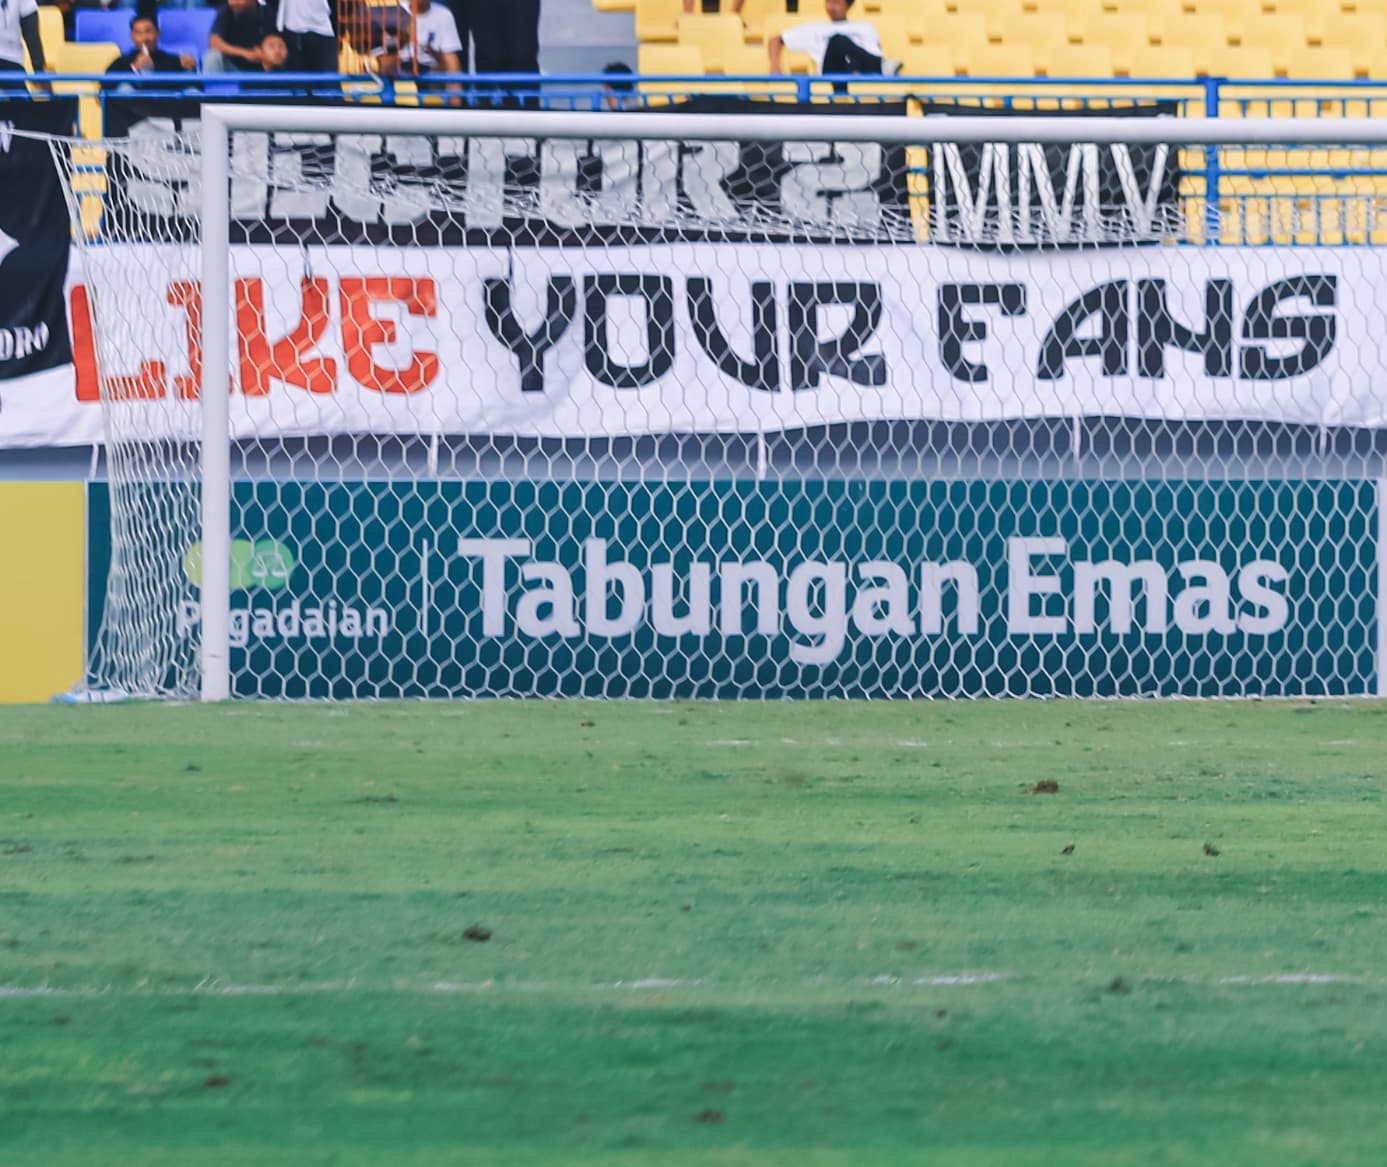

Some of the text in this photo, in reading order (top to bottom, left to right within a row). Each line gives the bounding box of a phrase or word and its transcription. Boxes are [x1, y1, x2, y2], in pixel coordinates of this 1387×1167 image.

[127, 116, 883, 231] SECTOR 2
[932, 142, 1170, 244] MMV
[483, 273, 888, 393] YOUR
[937, 274, 1338, 382] FANS
[177, 599, 389, 648] Pgadaian
[458, 536, 1291, 665] Tabungan Emas
